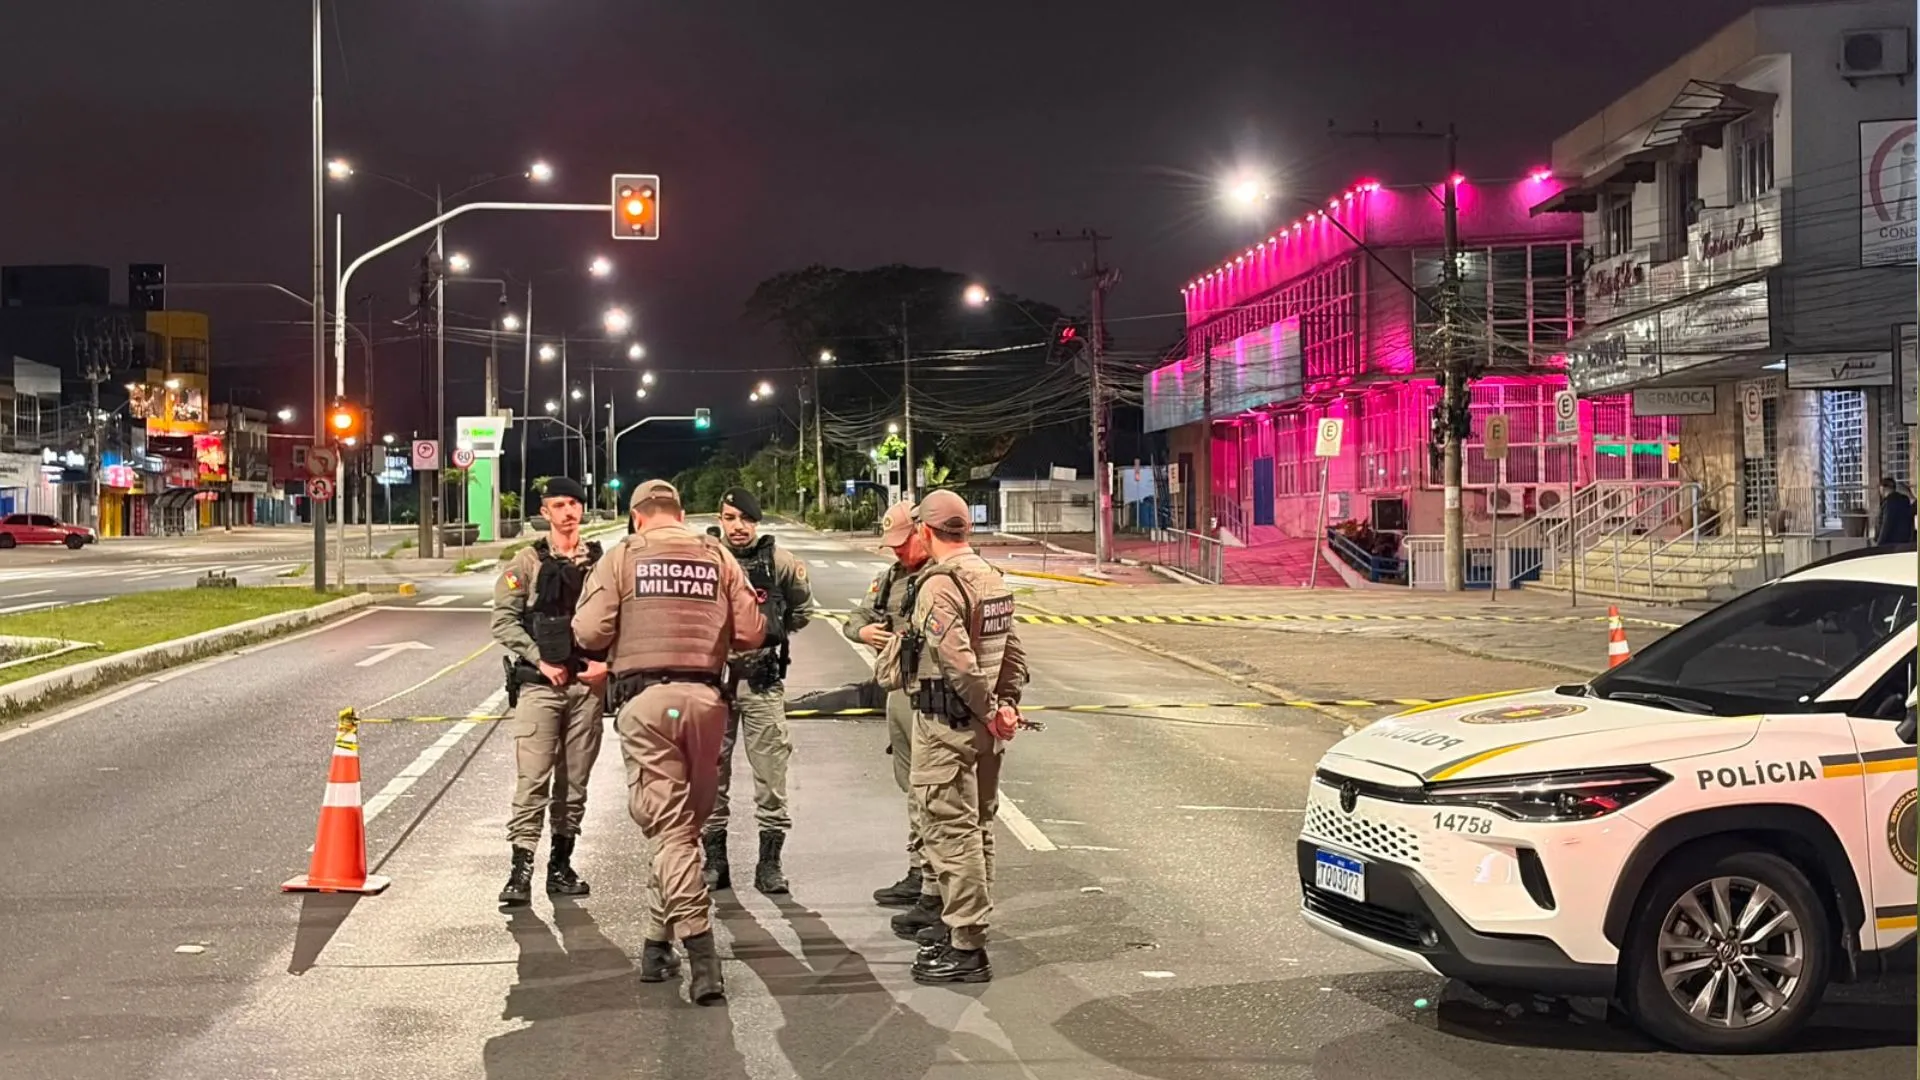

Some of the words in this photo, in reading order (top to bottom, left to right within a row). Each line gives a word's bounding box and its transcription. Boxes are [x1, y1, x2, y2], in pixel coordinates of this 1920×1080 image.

[1562, 398, 1570, 413] E
[1326, 425, 1334, 437] E
[1492, 425, 1500, 439] E
[457, 451, 471, 461] 60
[636, 563, 718, 580] BRIGADA
[640, 579, 714, 596] MILITAR
[1696, 760, 1816, 790] POLÍCIA
[1432, 811, 1493, 834] 14758
